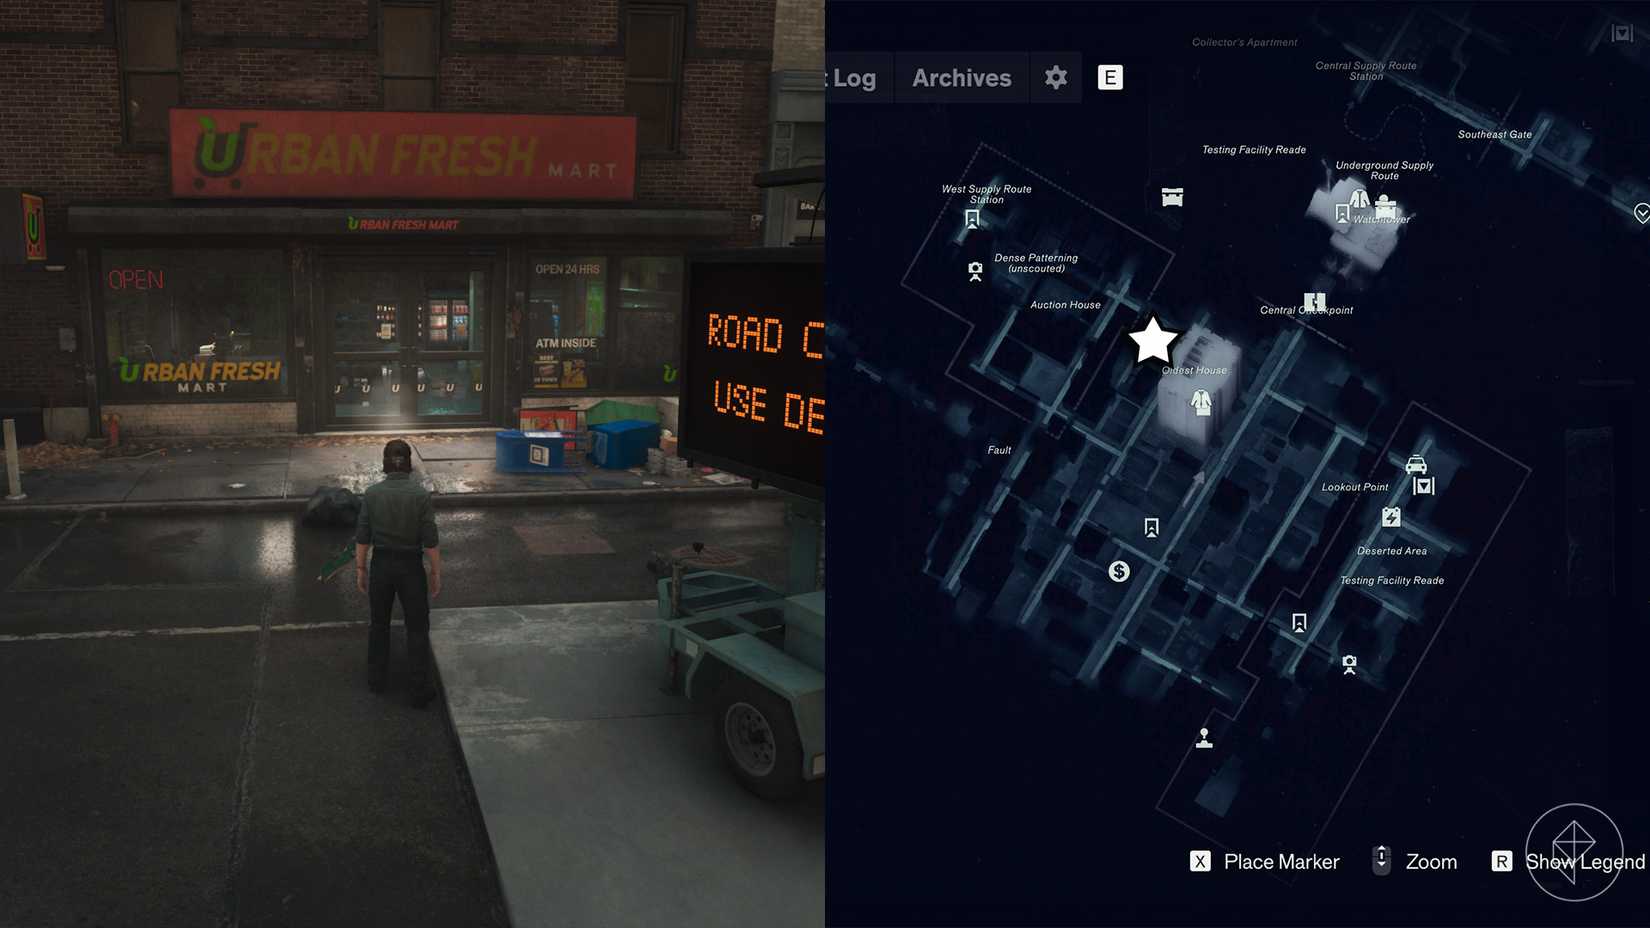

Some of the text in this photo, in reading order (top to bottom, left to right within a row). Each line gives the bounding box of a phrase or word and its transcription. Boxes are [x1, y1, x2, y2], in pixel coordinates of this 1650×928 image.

[1192, 38, 1298, 48] Collector's Apartment
[1315, 61, 1417, 72] Central Supply Route
[834, 68, 877, 91] Log
[912, 68, 1012, 87] Archives
[1105, 70, 1117, 85] E
[1349, 72, 1384, 81] Station
[1458, 130, 1533, 139] Southeast Gate
[195, 117, 618, 179] URBAN FRESH MART
[1203, 145, 1307, 156] Testing Facility Reade
[1336, 161, 1434, 172] Underground Supply
[1371, 172, 1399, 180] Route
[942, 184, 1032, 195] West Supply Route
[970, 195, 1004, 204] Station
[348, 216, 459, 231] URBAN FRESH MART
[994, 253, 1079, 264] Dense Patterning
[536, 264, 600, 274] OPEN 24 HRS
[1008, 264, 1065, 274] (unscouted)
[109, 269, 165, 290] OPEN
[1030, 301, 1101, 310] Auction House
[1260, 306, 1296, 315] Central
[708, 313, 783, 353] ROAD
[536, 338, 597, 348] ATM INSIDE
[119, 356, 282, 382] URBAN FRESH
[1161, 366, 1228, 375] Oldest House
[178, 382, 227, 392] MART
[714, 380, 825, 435] USE DE
[987, 446, 1012, 455] Fault
[1321, 483, 1389, 492] Lookout Point
[1357, 547, 1428, 556] Deserted Area
[1340, 576, 1445, 586] Testing Facility Reade
[1195, 854, 1341, 870] X Place Marker
[1406, 854, 1458, 870] Zoom
[1496, 854, 1646, 875] R Show Legend
